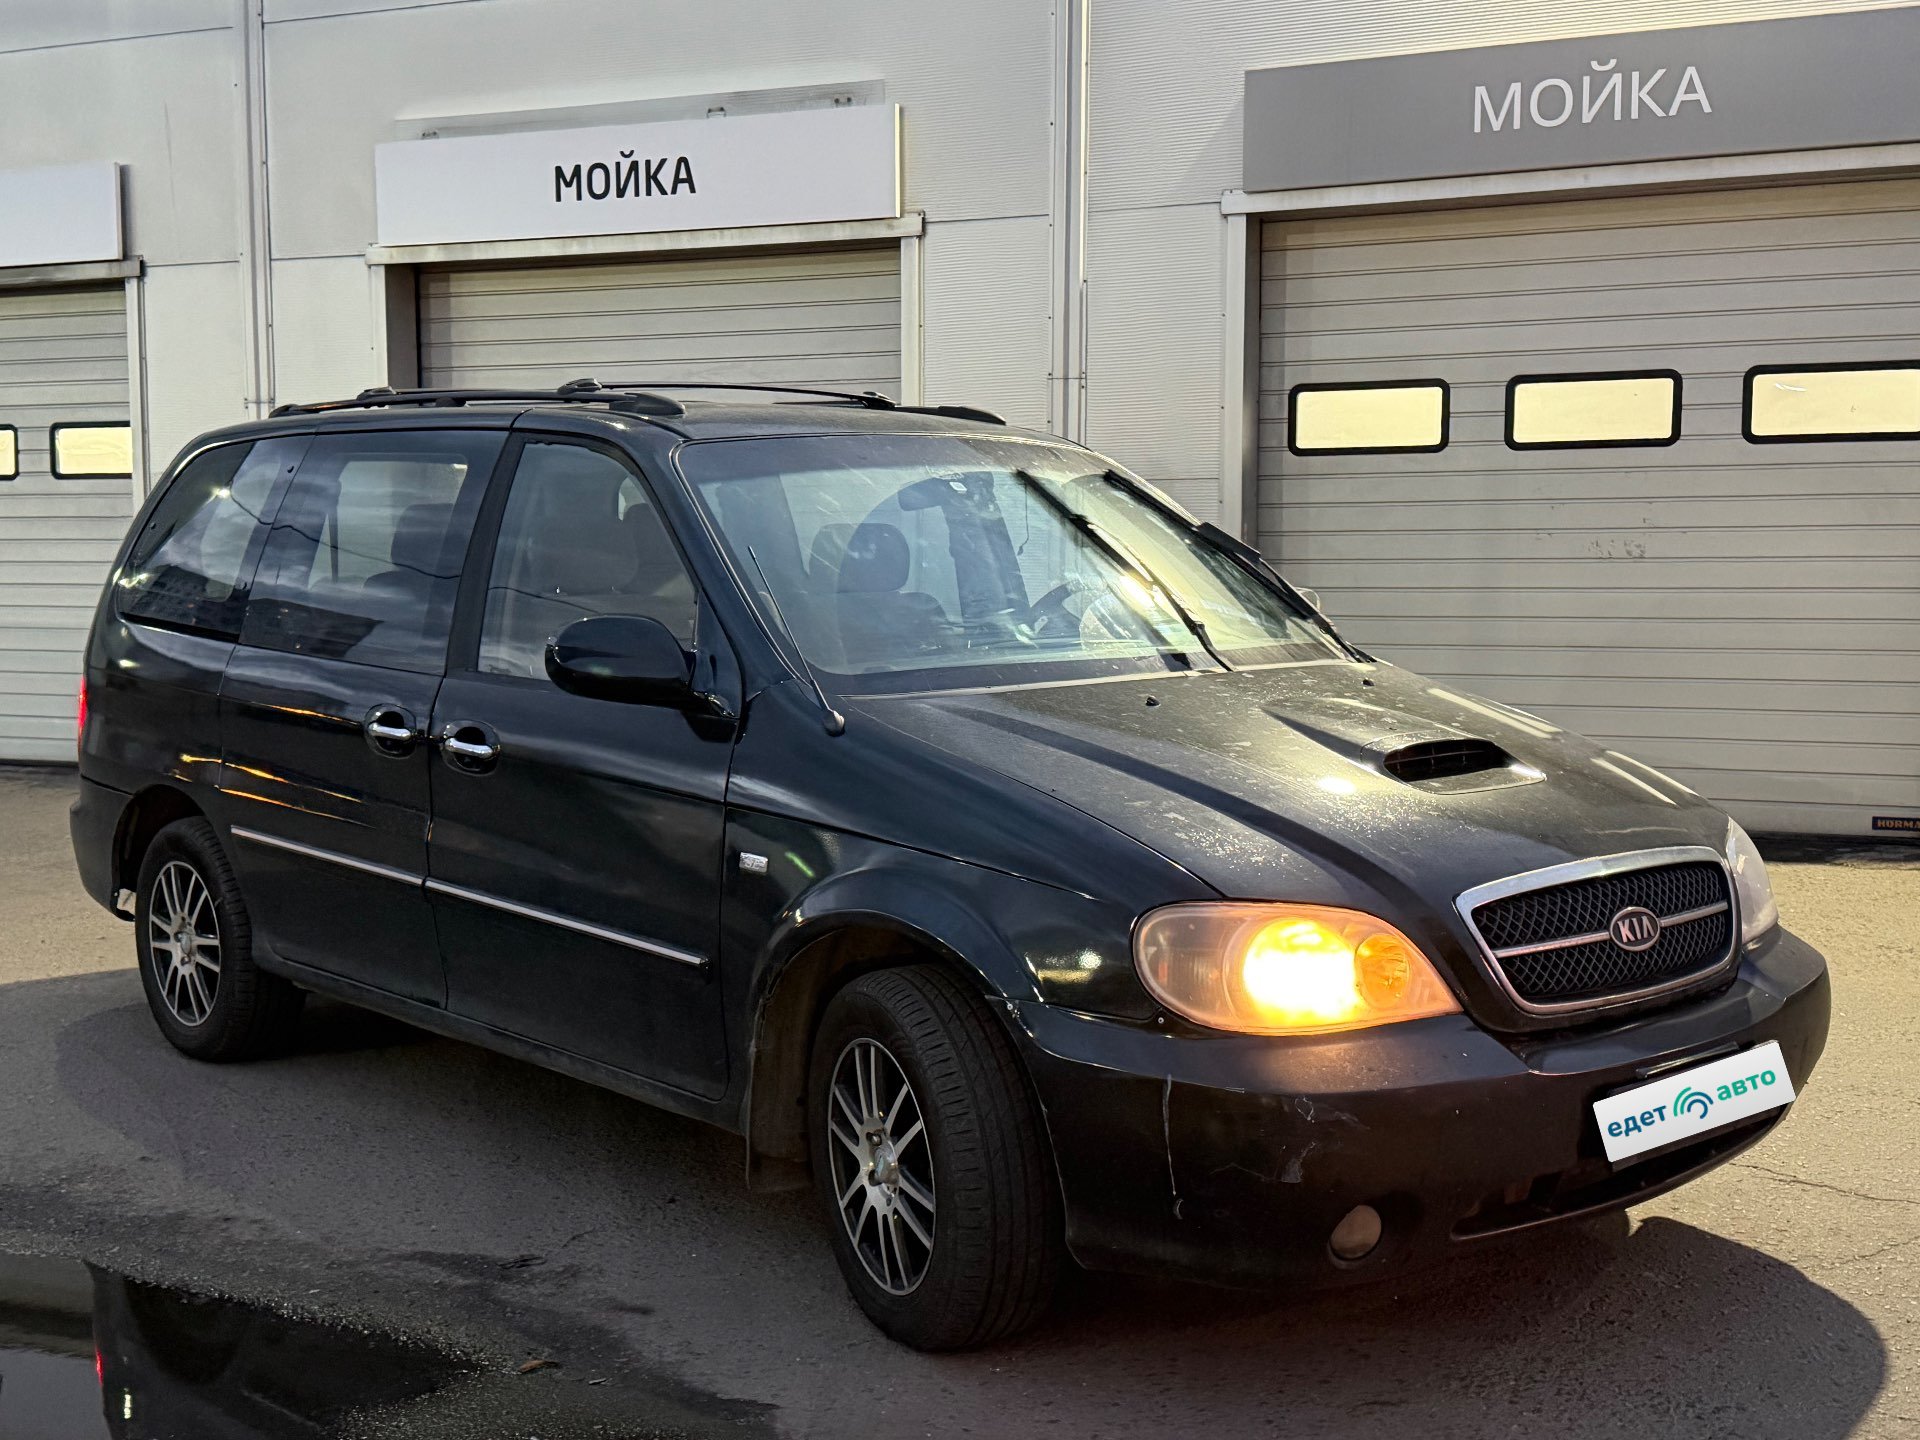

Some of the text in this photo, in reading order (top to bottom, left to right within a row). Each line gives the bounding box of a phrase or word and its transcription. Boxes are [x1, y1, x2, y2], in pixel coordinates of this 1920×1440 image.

[1473, 58, 1713, 133] МОЙКА
[554, 149, 697, 203] МОЙКА
[1616, 915, 1655, 943] KIA
